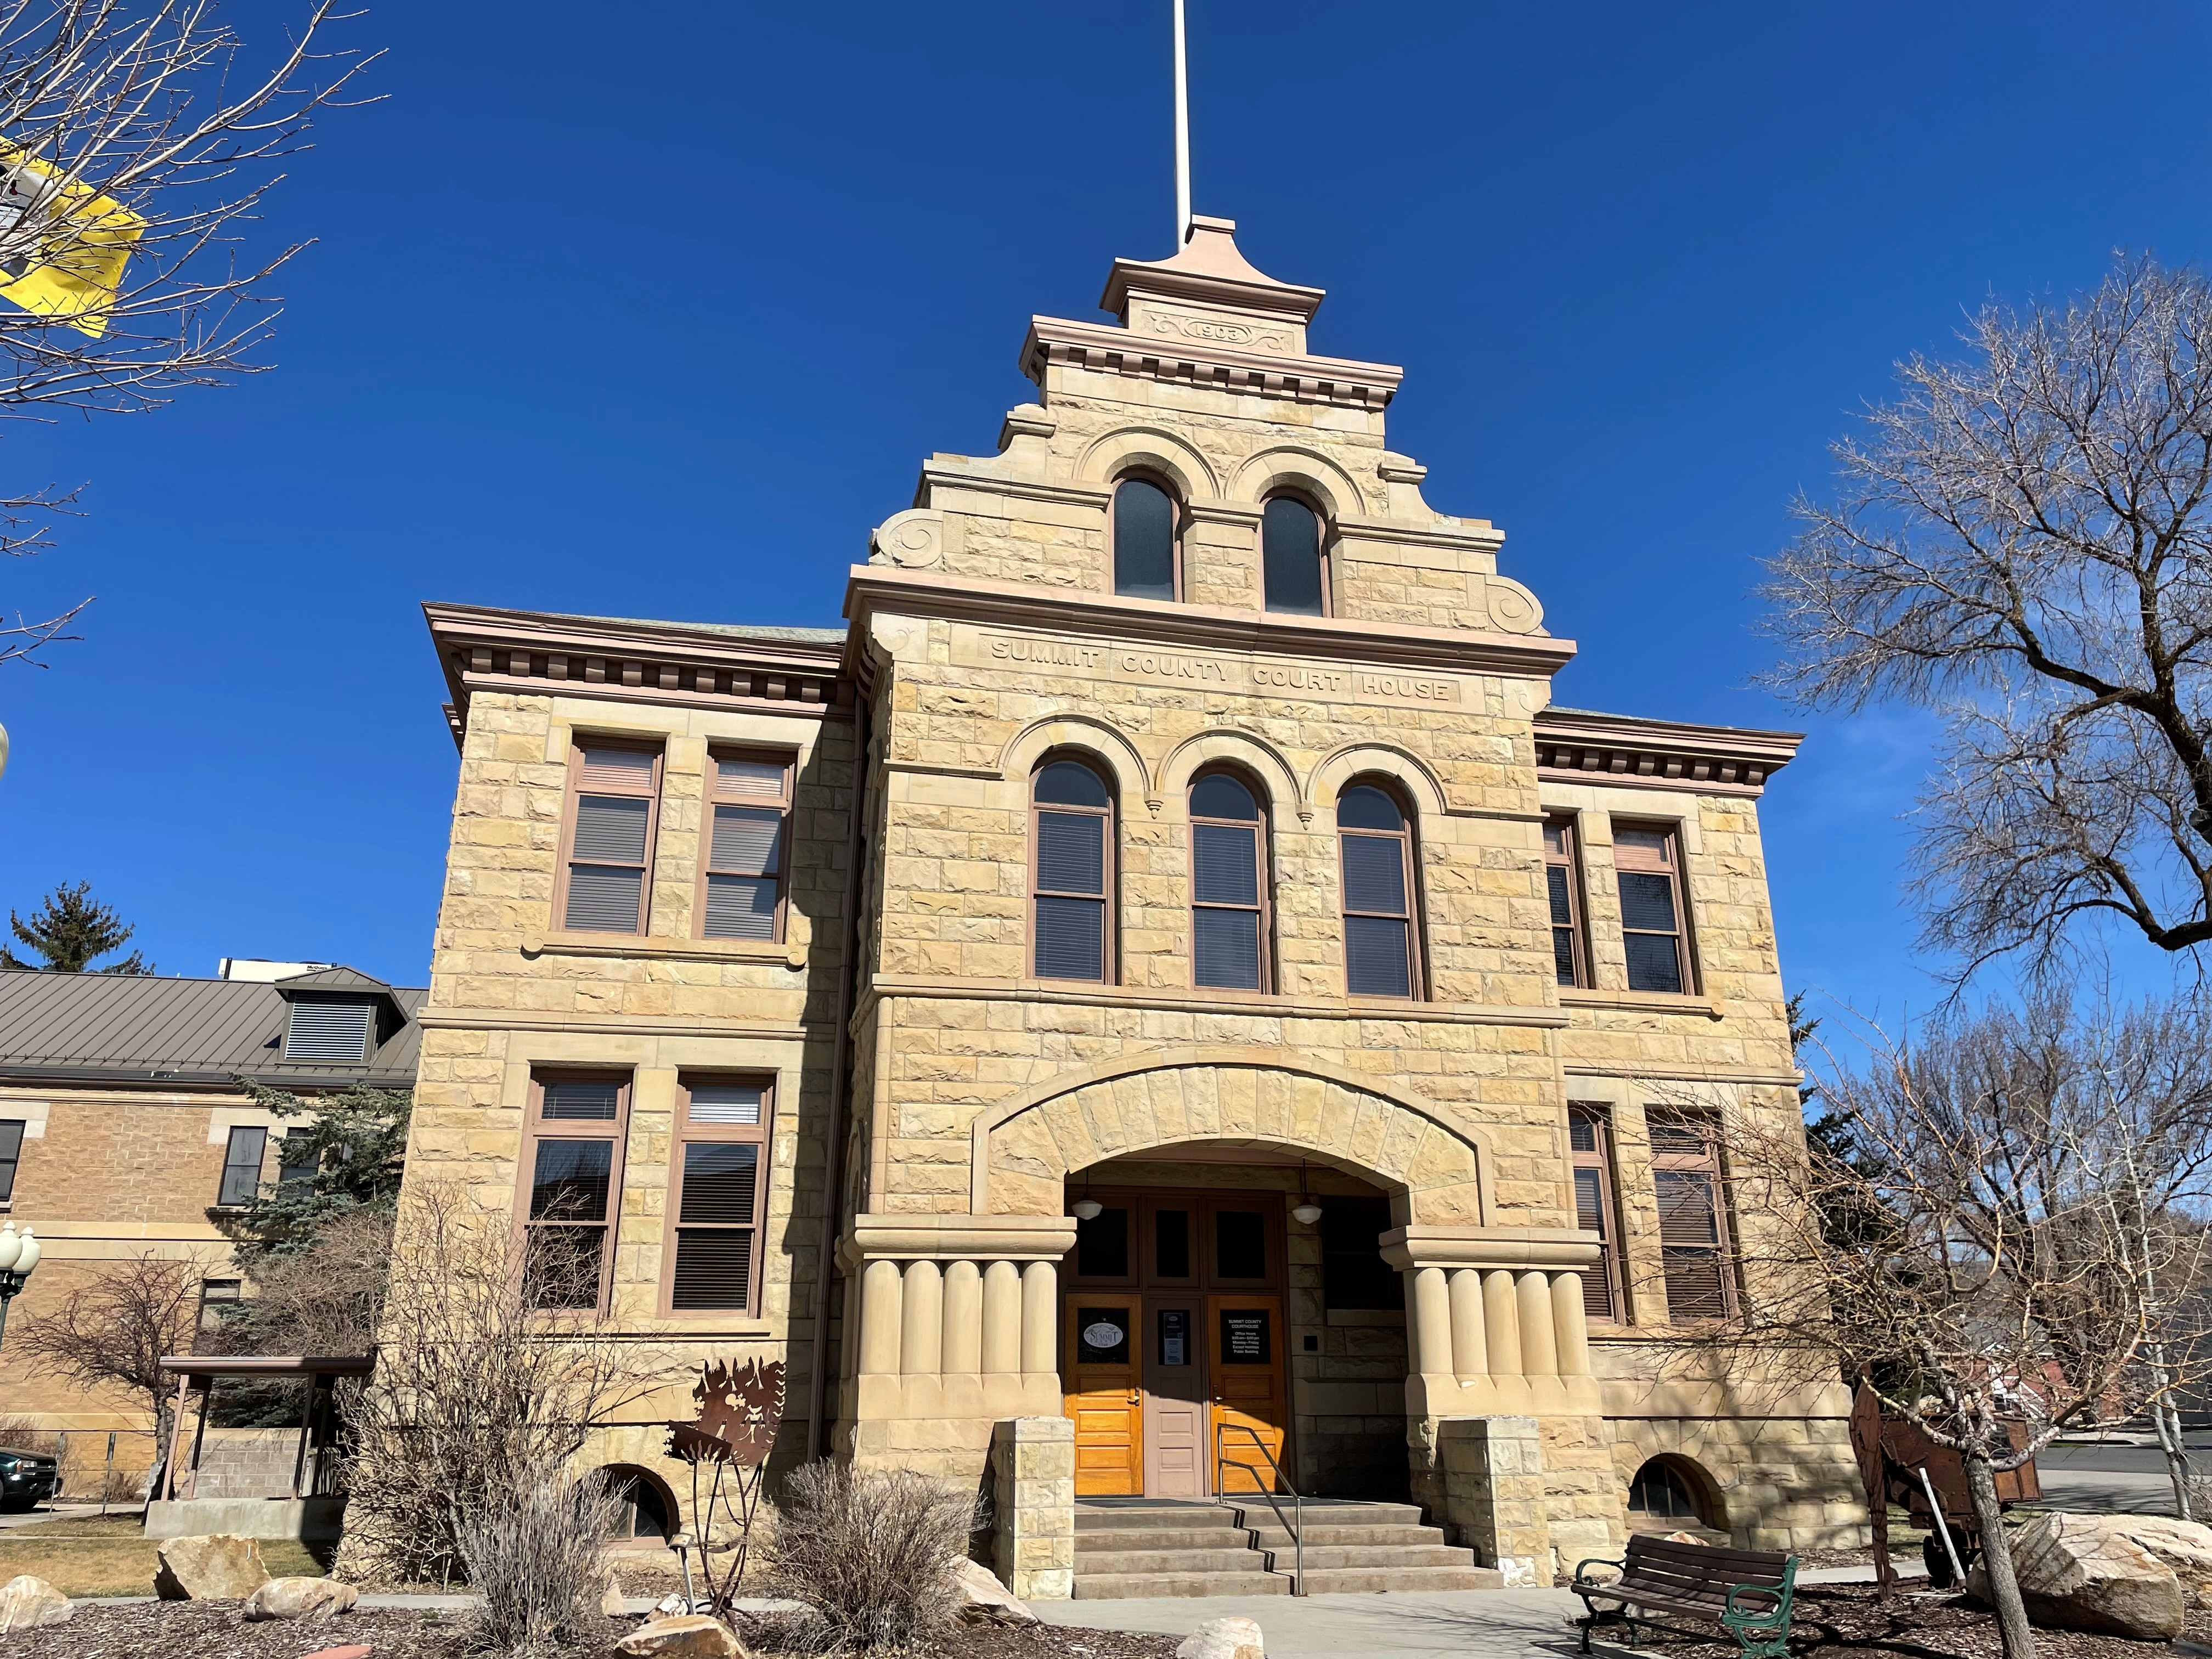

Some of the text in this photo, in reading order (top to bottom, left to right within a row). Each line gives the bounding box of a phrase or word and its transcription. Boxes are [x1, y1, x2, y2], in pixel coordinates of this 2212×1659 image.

[1196, 324, 1239, 340] 1903
[992, 640, 1449, 701] SUMMIT COUNTY COURT HOUSE
[1090, 1331, 1118, 1342] SUMMIT
